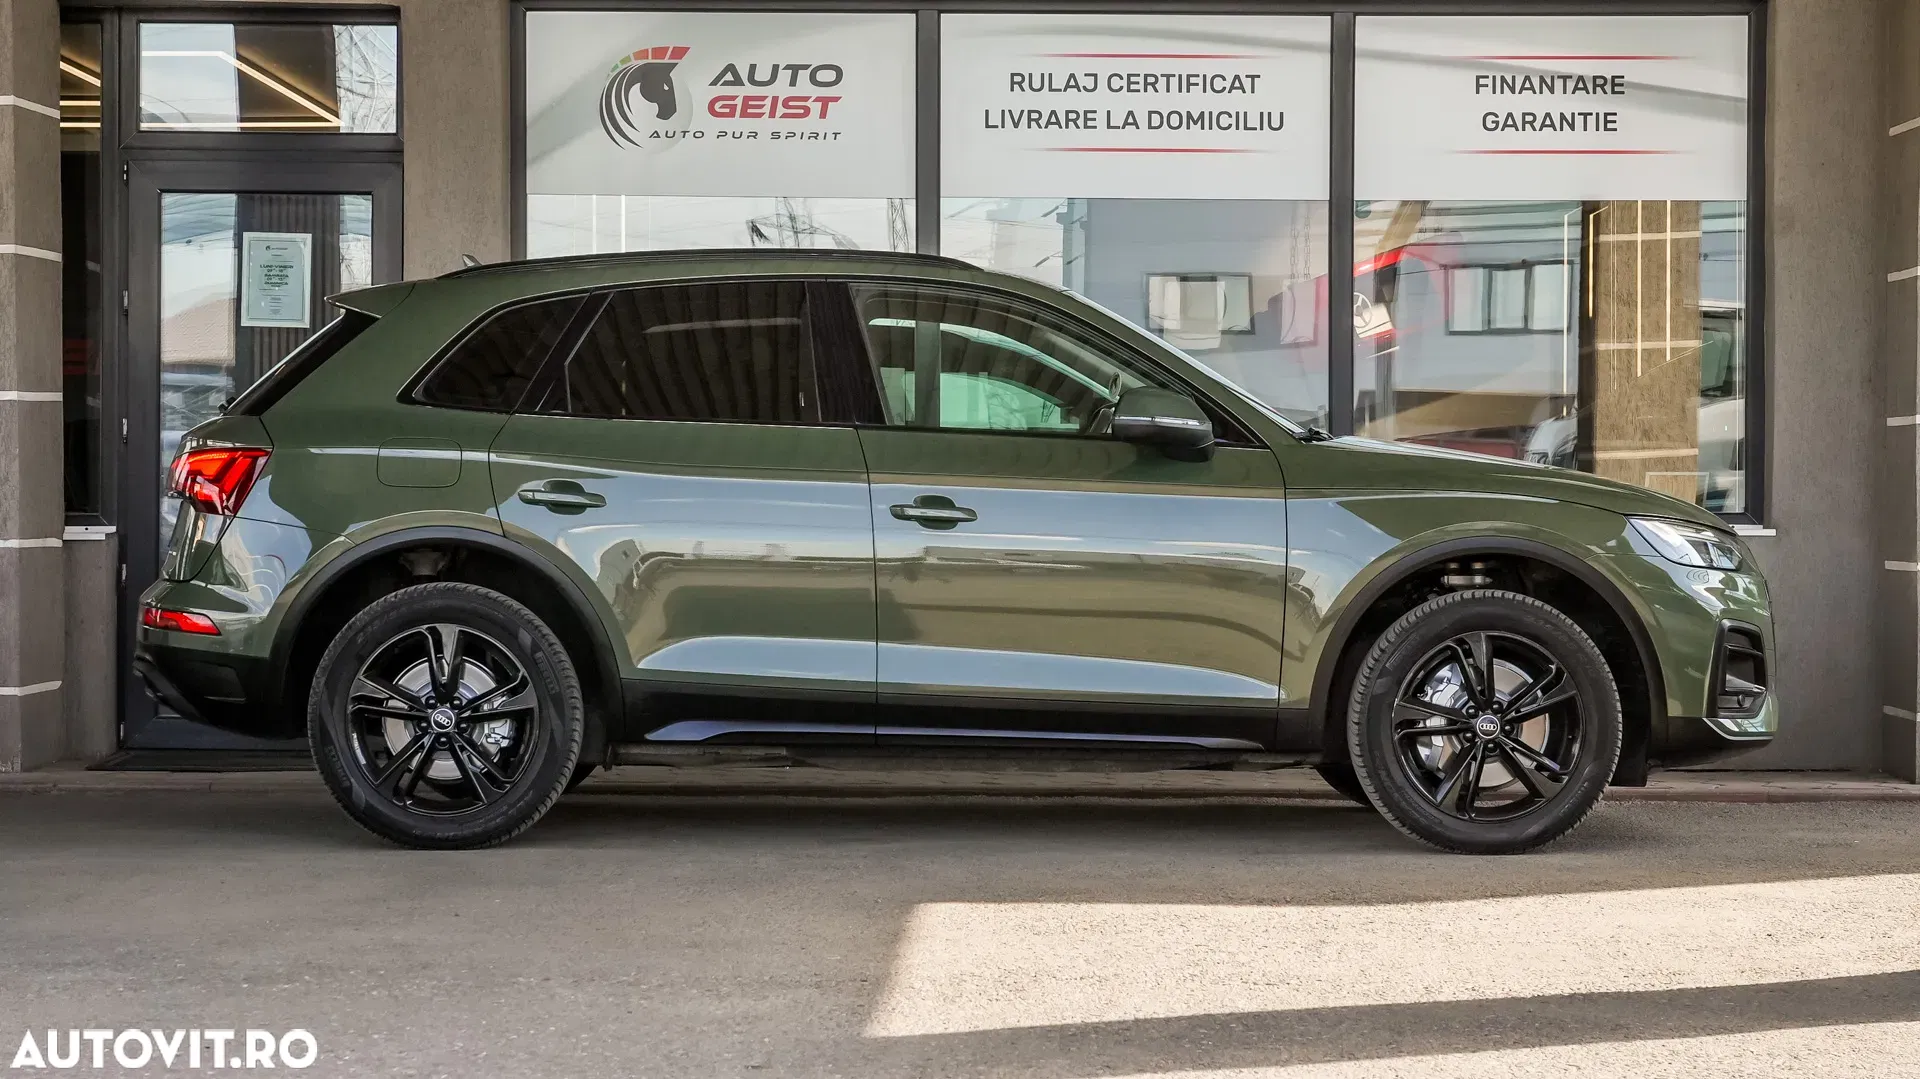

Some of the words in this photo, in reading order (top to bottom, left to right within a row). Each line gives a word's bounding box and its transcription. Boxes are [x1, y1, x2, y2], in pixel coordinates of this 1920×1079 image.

[708, 63, 844, 88] AUTO
[1010, 72, 1098, 93] RULAJ
[1107, 73, 1261, 94] CERTIFICAT
[1475, 74, 1626, 95] FINANTARE
[707, 95, 842, 119] GEIST
[984, 109, 1098, 130] LIVRARE
[1106, 110, 1140, 130] LA
[1147, 110, 1285, 132] DOMICILIU
[1482, 111, 1618, 132] GARANTIE
[649, 130, 705, 139] AUTO
[717, 131, 758, 140] PUR
[770, 131, 842, 140] SPIRIT
